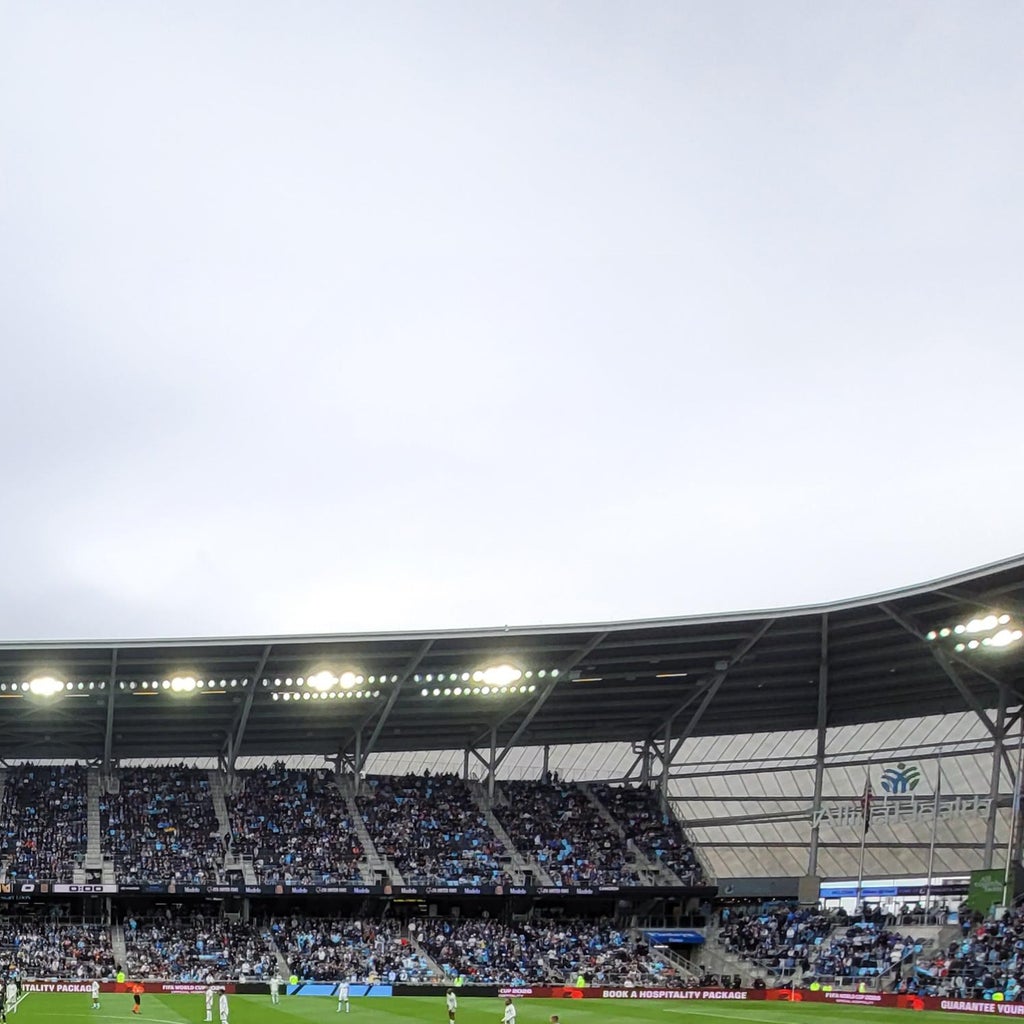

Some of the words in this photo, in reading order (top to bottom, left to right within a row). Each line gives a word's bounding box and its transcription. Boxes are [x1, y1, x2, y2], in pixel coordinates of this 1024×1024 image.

[56, 983, 94, 992] PACKAG
[603, 990, 628, 998] BOOK
[639, 991, 701, 999] HOSPITALITY
[703, 991, 748, 999] PACKAGE
[941, 1000, 996, 1012] GUARANTEE
[997, 1003, 1024, 1014] YOUR
